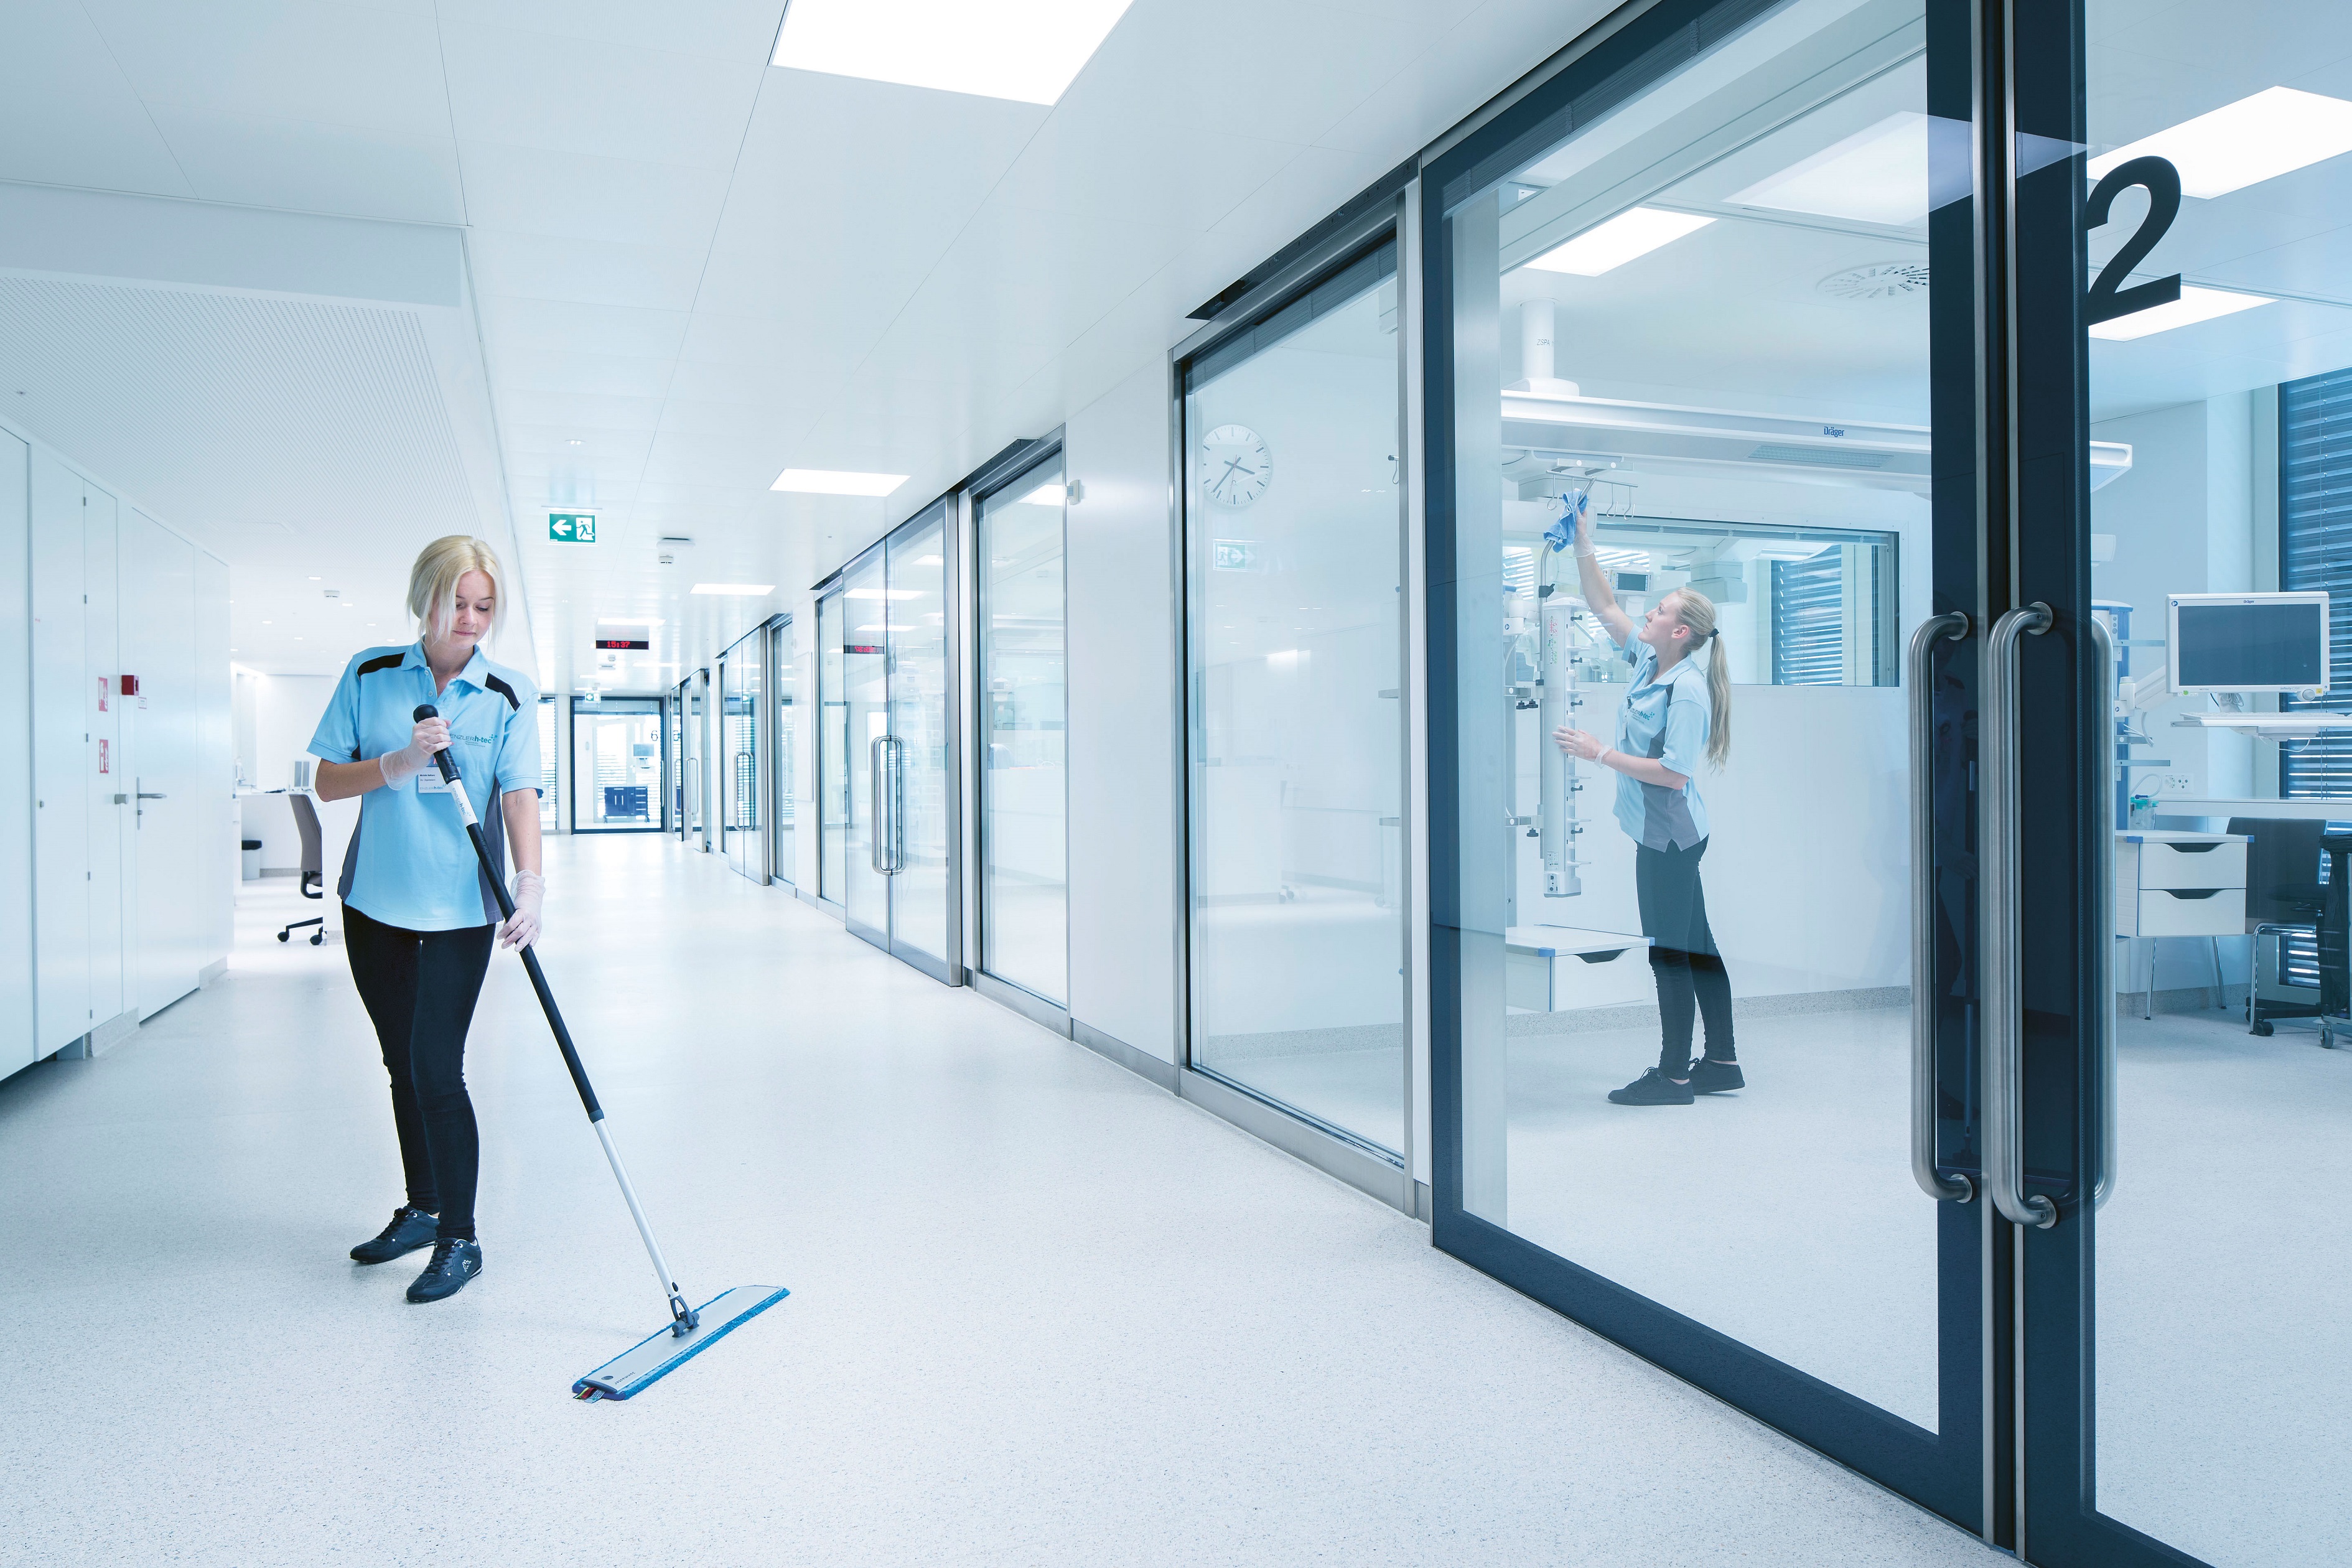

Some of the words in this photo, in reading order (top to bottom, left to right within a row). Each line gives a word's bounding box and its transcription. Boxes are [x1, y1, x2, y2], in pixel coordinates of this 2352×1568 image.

[2083, 156, 2182, 327] 2
[1824, 426, 1844, 437] Dräger
[651, 730, 658, 741] 6
